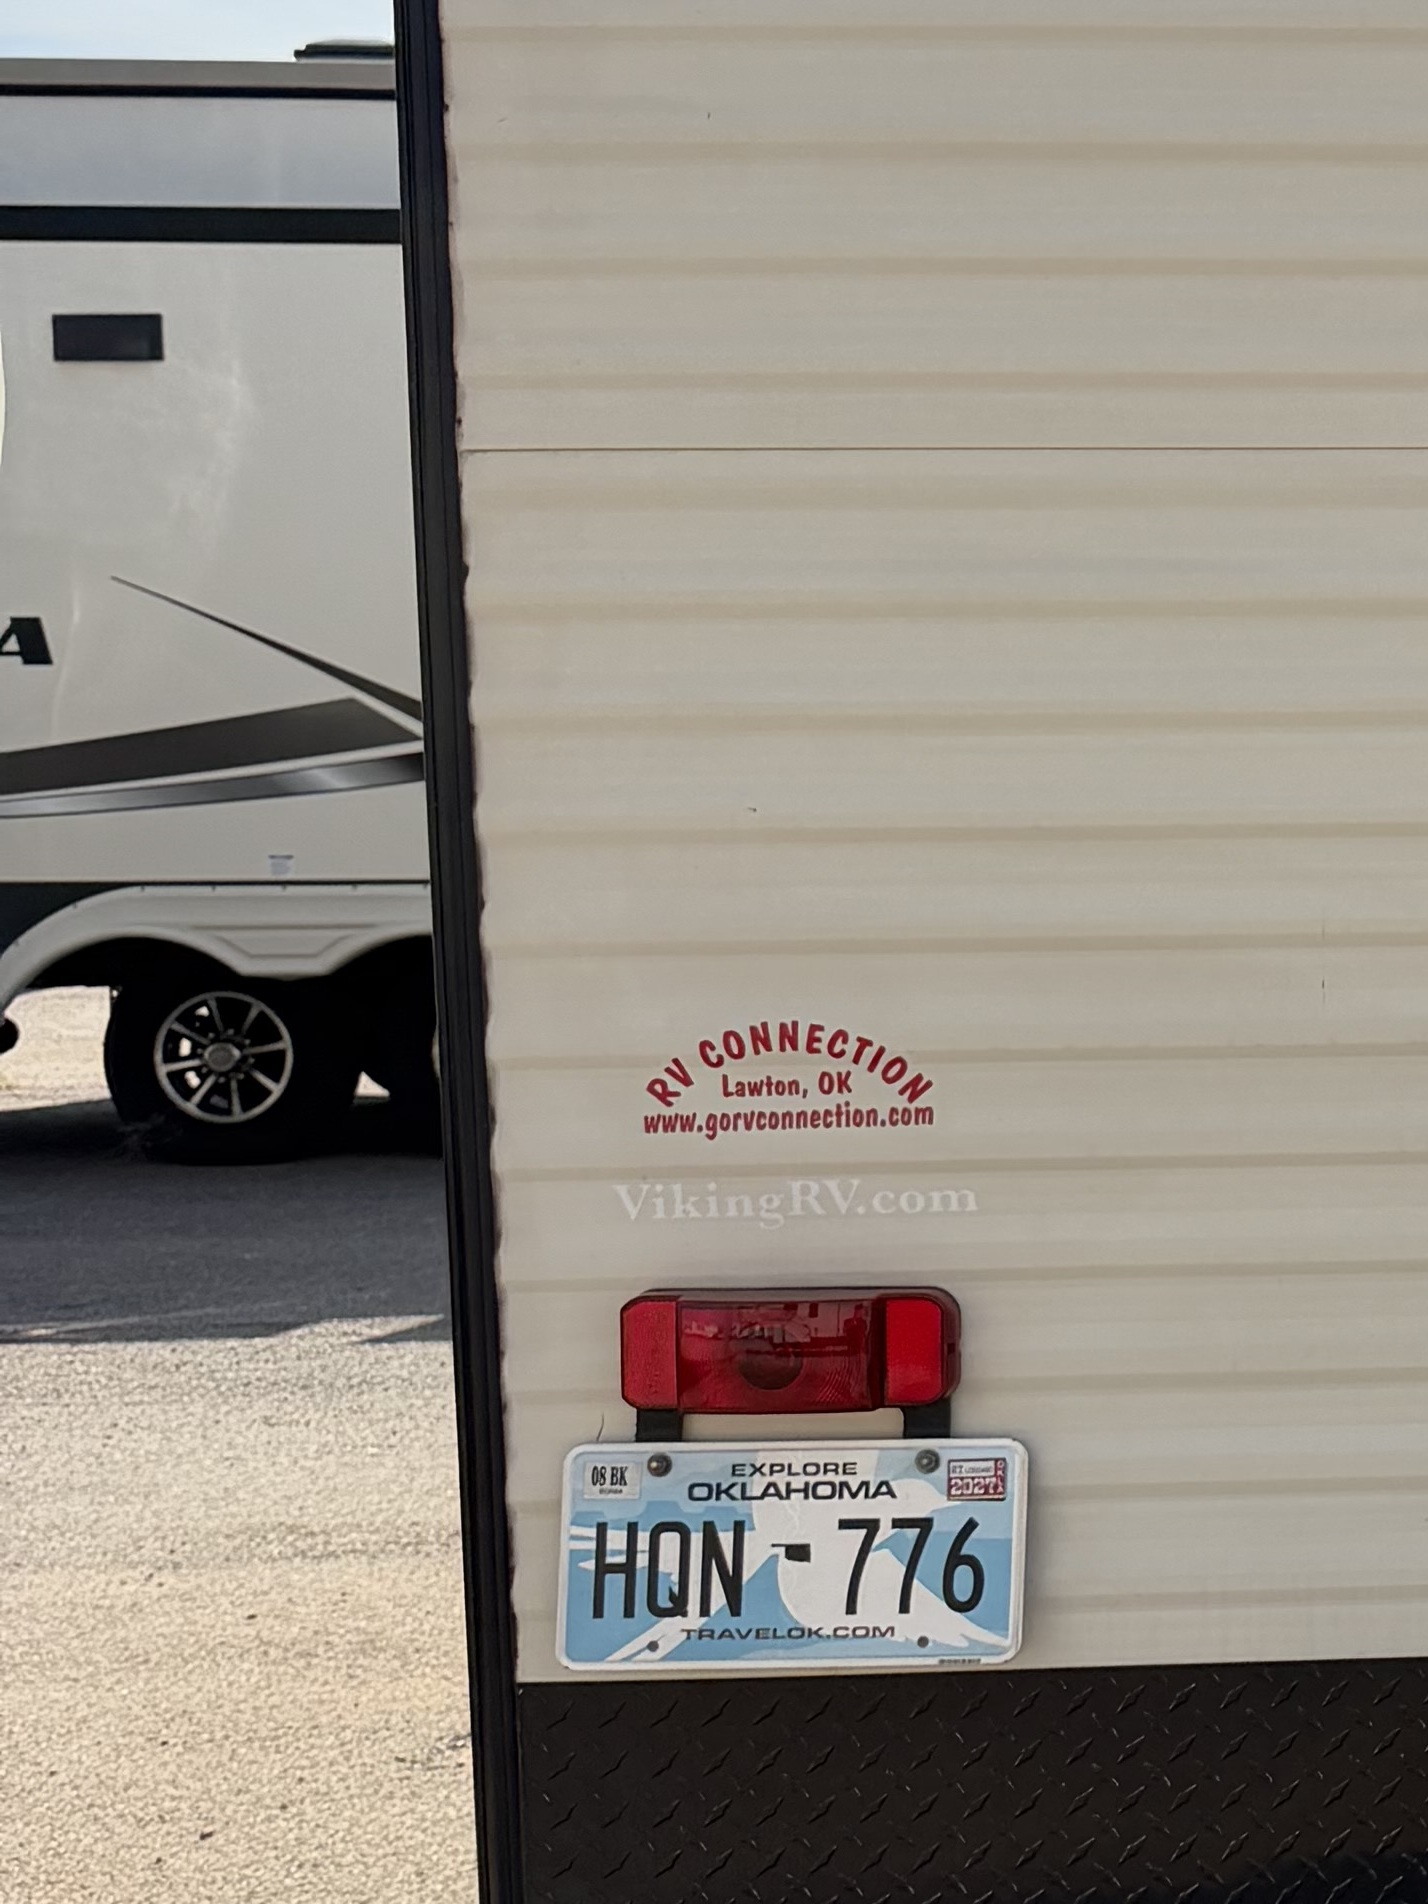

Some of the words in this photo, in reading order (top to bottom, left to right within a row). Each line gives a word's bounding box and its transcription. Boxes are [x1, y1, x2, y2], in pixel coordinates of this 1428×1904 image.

[645, 1057, 695, 1107] RV
[698, 1020, 934, 1104] CONNECTION
[721, 1074, 809, 1099] Lawton,
[818, 1070, 852, 1095] OK
[643, 1101, 934, 1141] www.gorvconnection.com
[611, 1177, 979, 1231] VikingRV.com
[591, 1465, 607, 1486] 08
[610, 1466, 629, 1486] BK
[731, 1462, 858, 1477] EXPLORE
[687, 1480, 898, 1502] OKLAHOMA
[950, 1477, 997, 1495] 2027
[592, 1520, 746, 1620] HQN
[837, 1516, 986, 1615] 776
[680, 1625, 896, 1641] TRAVELOK.COM
